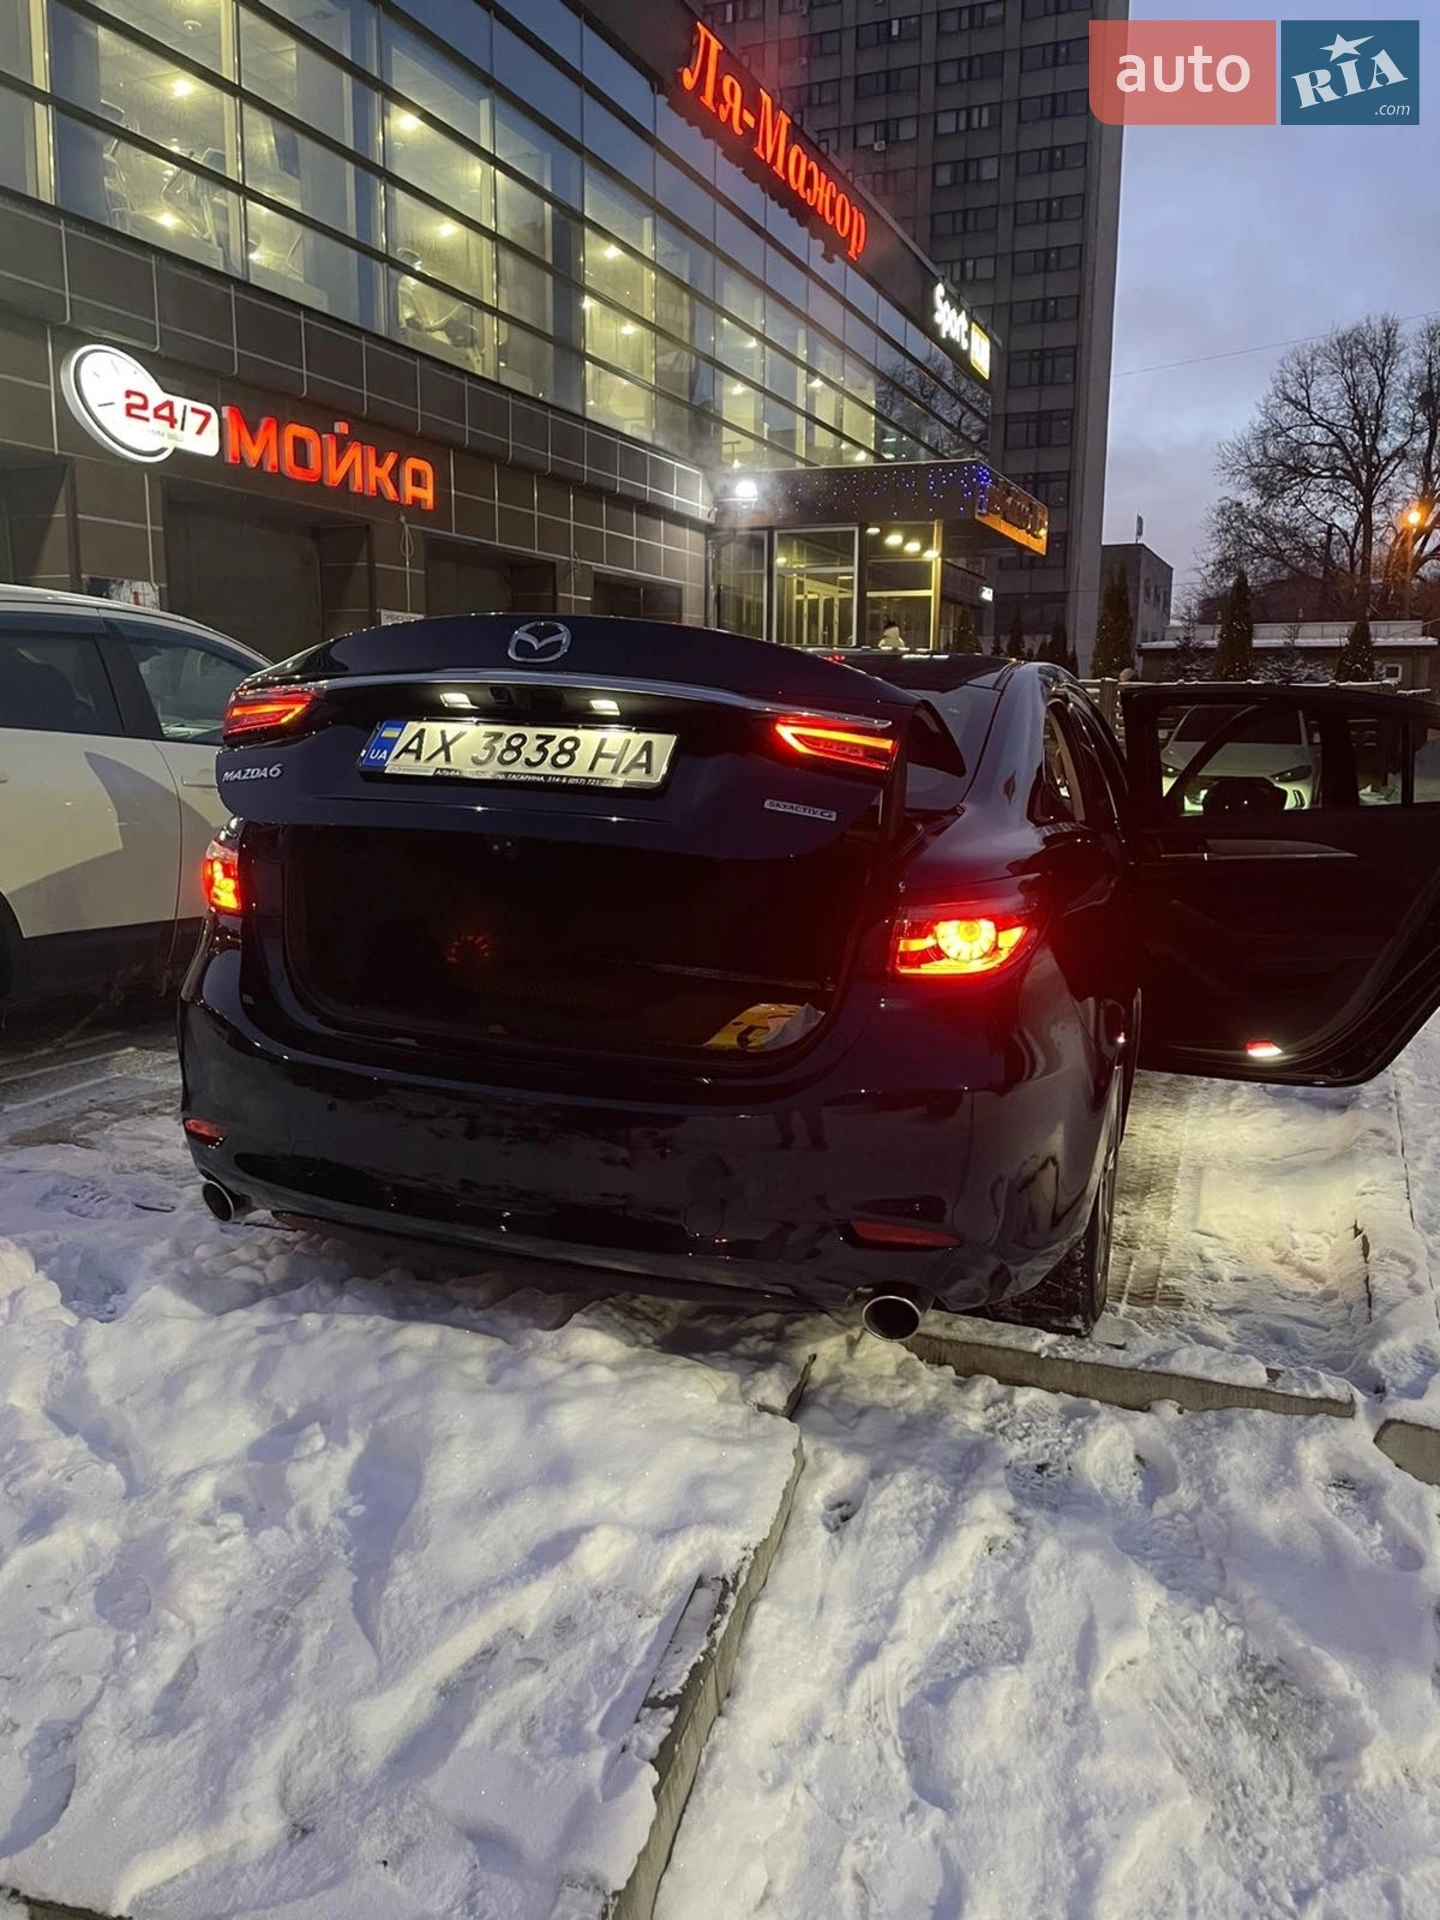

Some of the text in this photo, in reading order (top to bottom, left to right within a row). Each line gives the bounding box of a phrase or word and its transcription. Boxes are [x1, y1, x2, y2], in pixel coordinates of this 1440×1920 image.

[682, 21, 868, 262] Ля-Мажор
[223, 405, 435, 510] МОЙКА
[369, 748, 388, 761] UA
[393, 727, 655, 777] AX 3838 HA
[222, 763, 283, 782] MAZDA6
[767, 801, 819, 816] SKYACTIV
